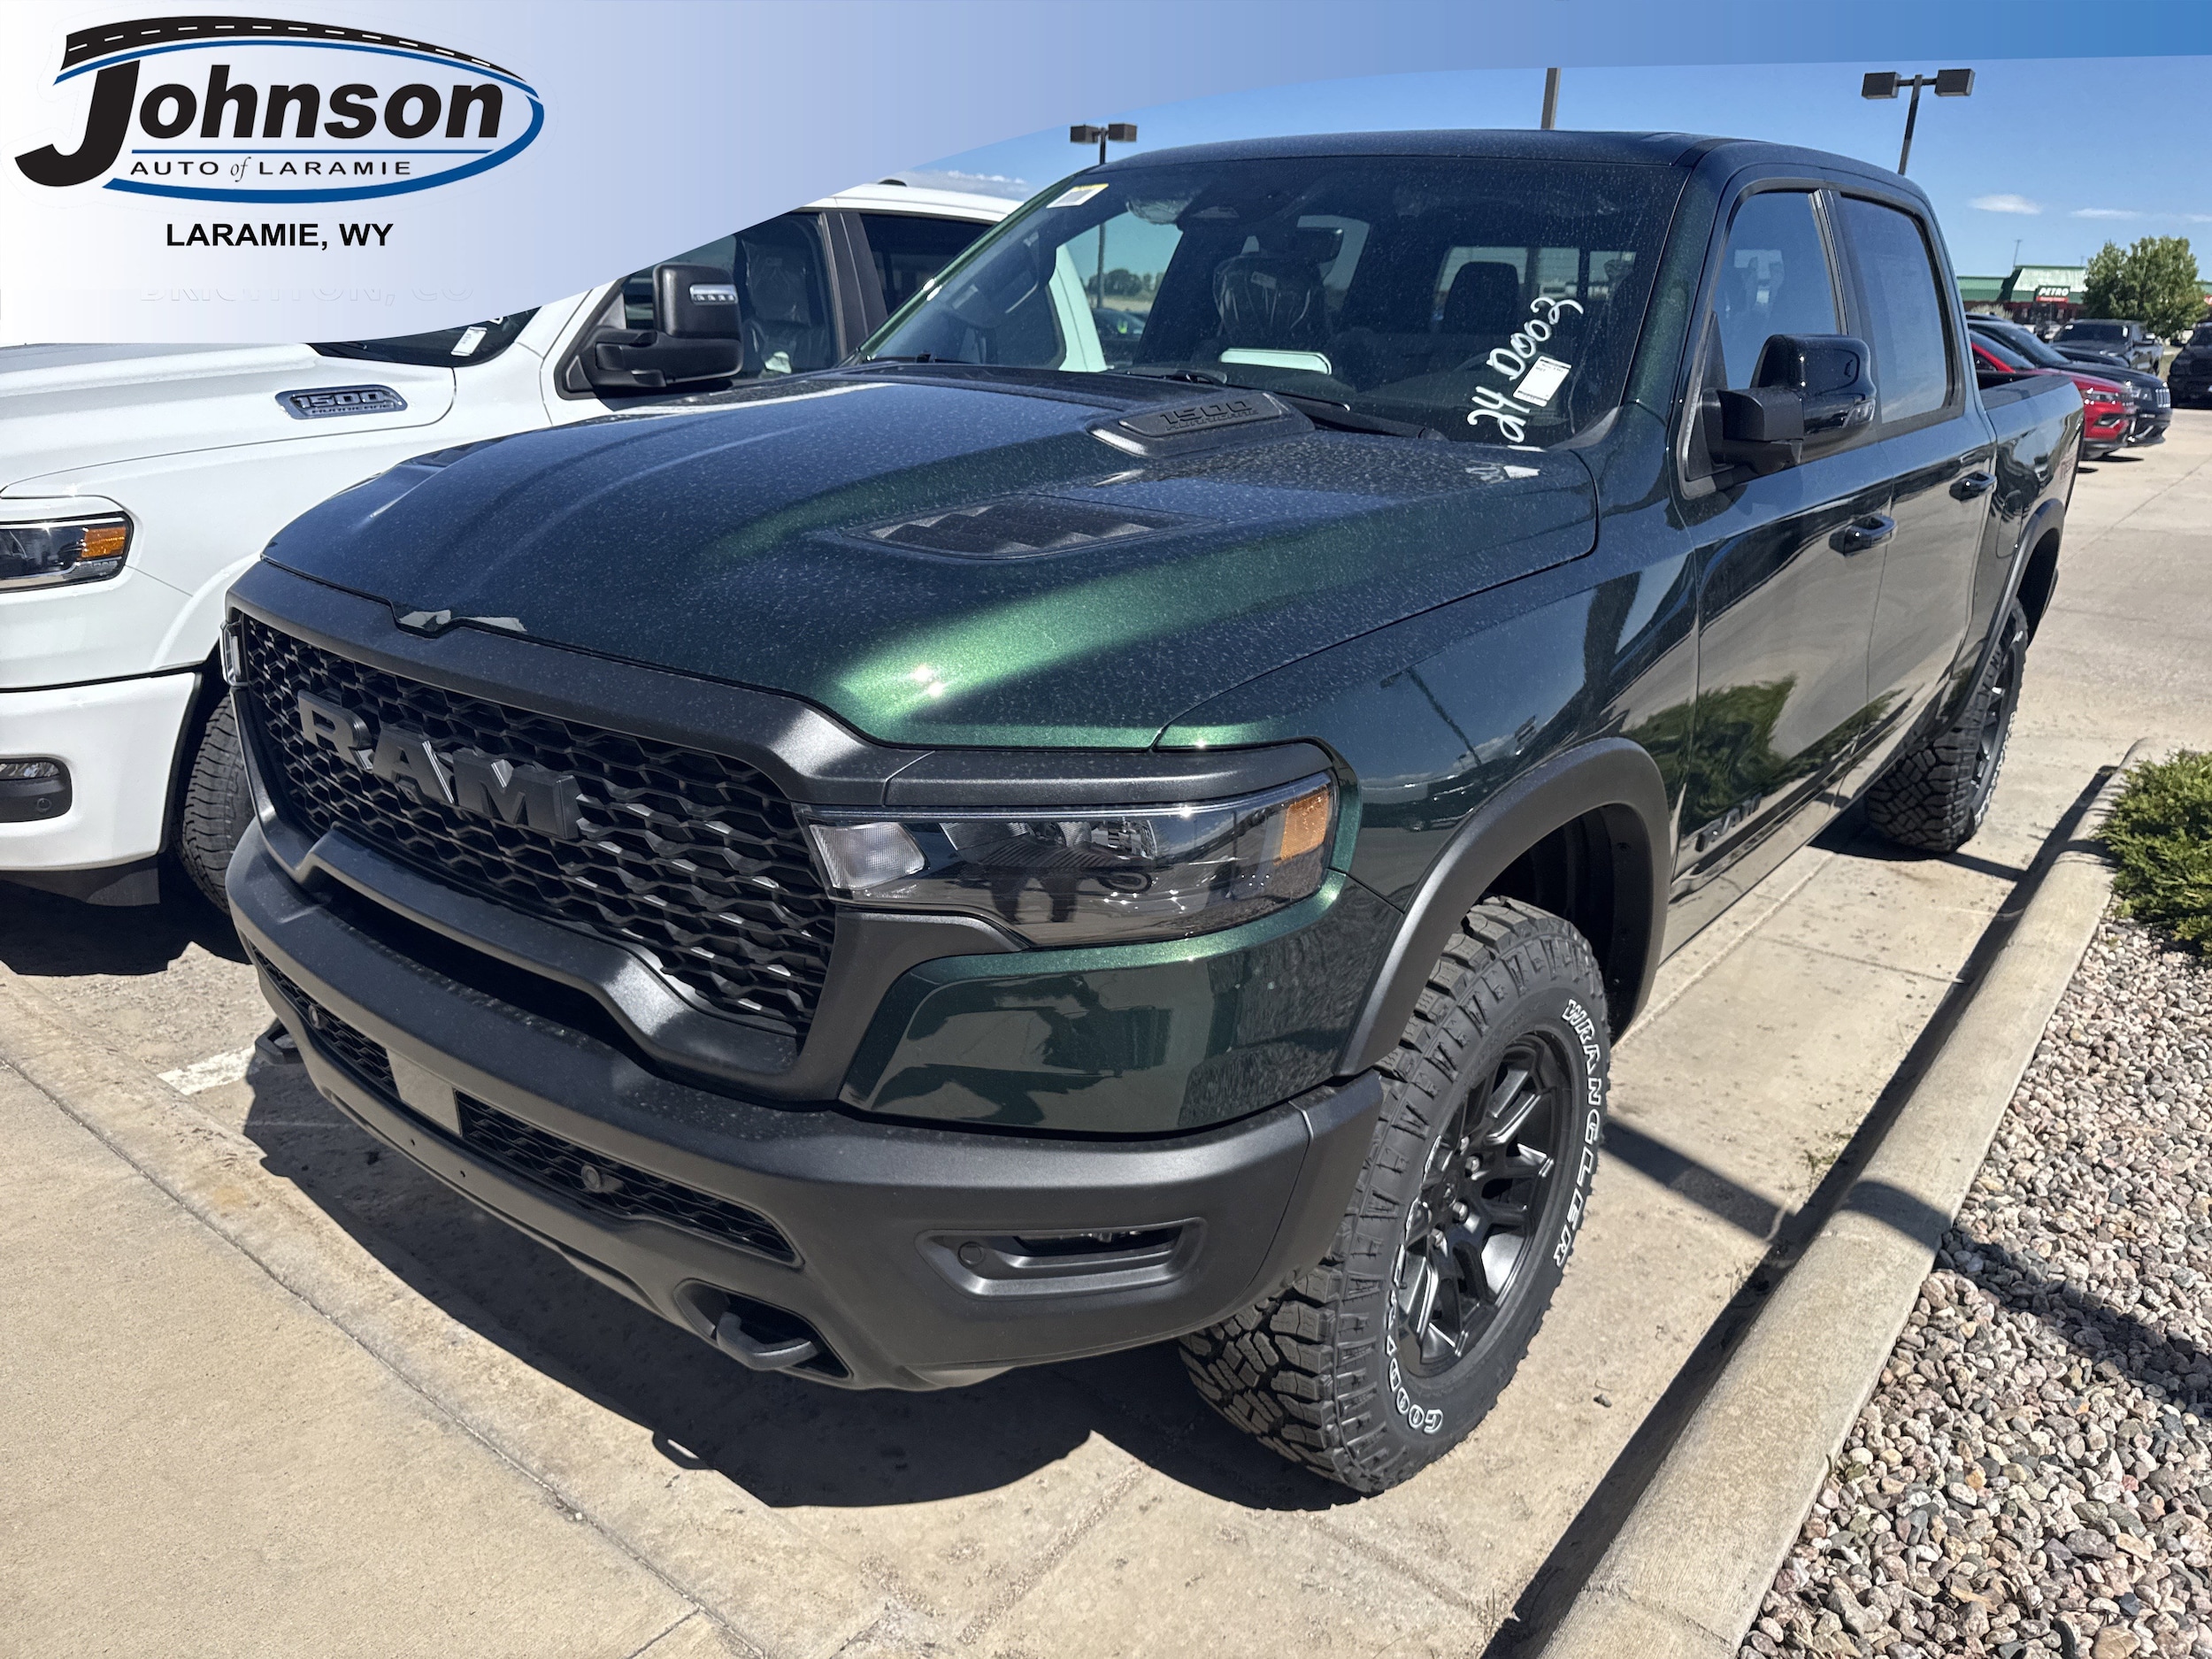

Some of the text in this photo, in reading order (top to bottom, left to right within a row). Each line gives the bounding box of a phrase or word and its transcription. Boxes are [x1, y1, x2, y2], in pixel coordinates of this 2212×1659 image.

[2038, 287, 2070, 296] PETRO
[296, 390, 386, 409] 1500
[1159, 400, 1254, 425] 1500
[297, 689, 580, 840] RAM
[1553, 998, 1601, 1268] WRANGLER
